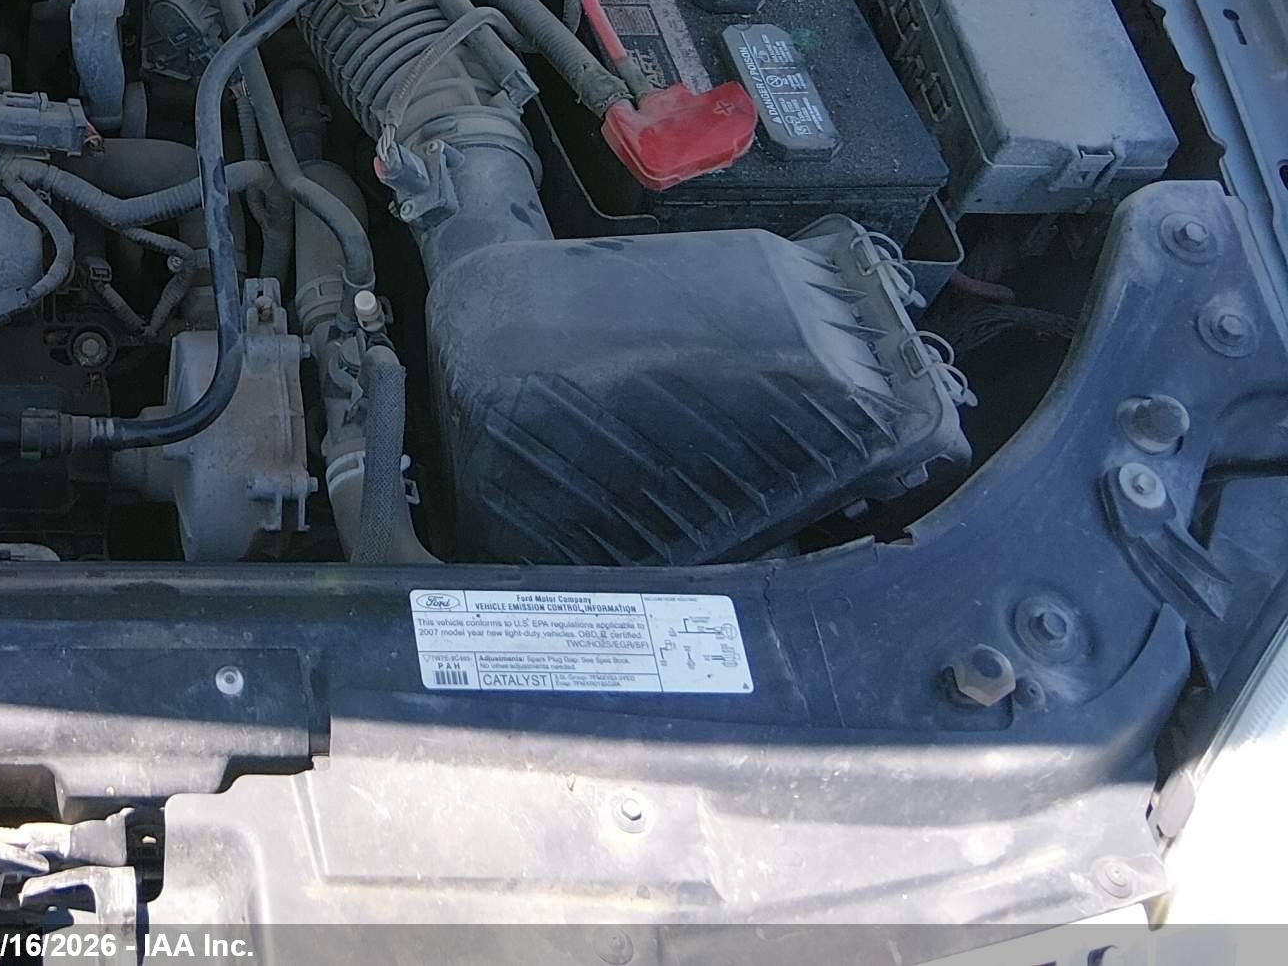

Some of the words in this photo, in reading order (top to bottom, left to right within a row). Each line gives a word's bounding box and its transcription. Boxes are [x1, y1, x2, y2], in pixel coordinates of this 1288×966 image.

[739, 47, 759, 75] POISON
[756, 83, 778, 116] DANGER
[425, 595, 451, 608] Ford
[516, 594, 533, 602] Ford
[535, 595, 556, 603] Motor
[558, 595, 592, 604] Company
[508, 603, 545, 611] EMISSION
[417, 618, 434, 626] This
[437, 618, 463, 626] vehicle
[466, 618, 502, 626] conforms
[551, 620, 594, 629] regulations
[596, 621, 634, 630] applicable
[441, 628, 464, 636] model
[504, 629, 540, 639] light-duty
[482, 674, 547, 687] CATALYST
